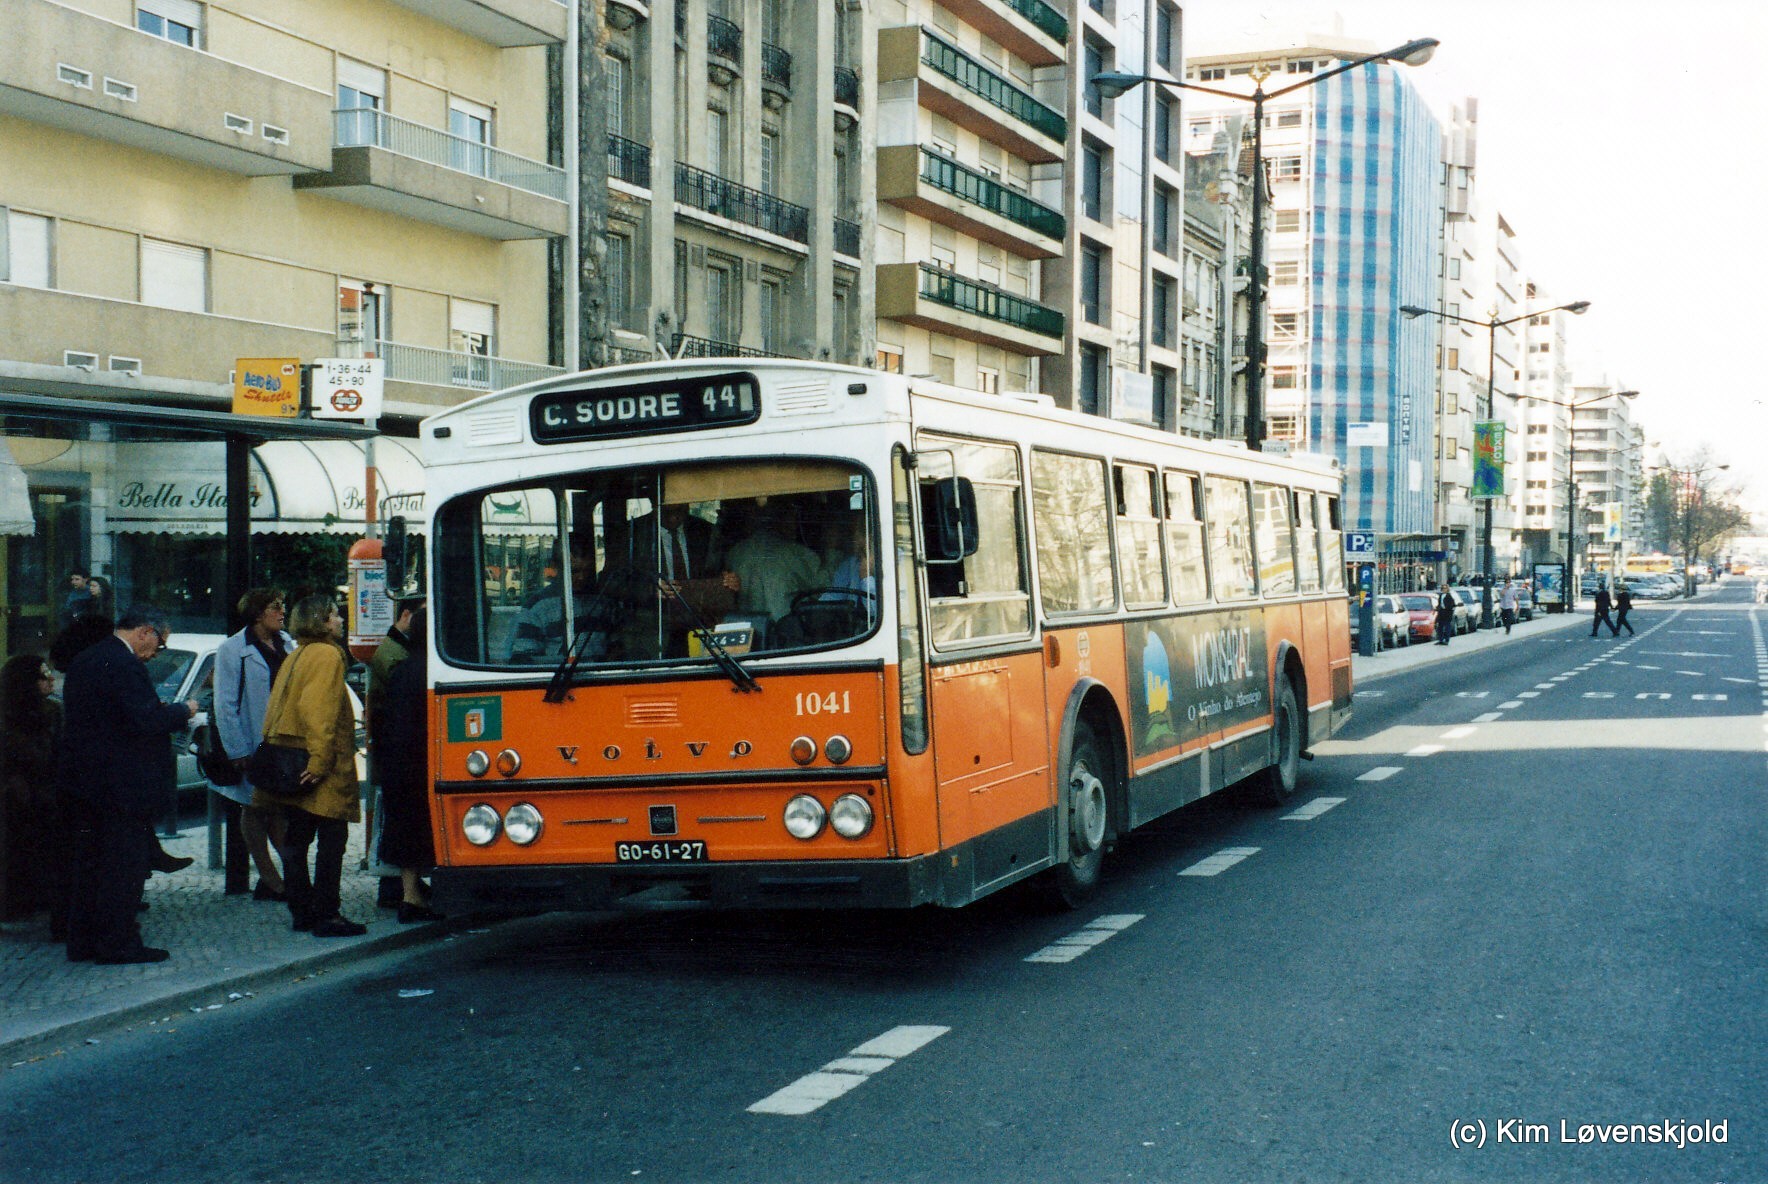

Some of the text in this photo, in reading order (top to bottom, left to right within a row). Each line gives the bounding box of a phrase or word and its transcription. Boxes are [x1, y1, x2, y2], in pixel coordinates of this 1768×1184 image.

[329, 376, 365, 386] 45-90
[543, 383, 736, 426] C. SODRE 44
[119, 481, 184, 508] Bella
[343, 486, 388, 510] Bea
[1351, 534, 1366, 551] P
[1361, 570, 1370, 579] P
[1192, 627, 1254, 689] MONSARAZ
[795, 690, 851, 716] 1041
[1223, 696, 1234, 711] do
[1352, 690, 1490, 698] BS
[556, 738, 753, 762] VOLVO
[617, 842, 704, 861] GO-61-27
